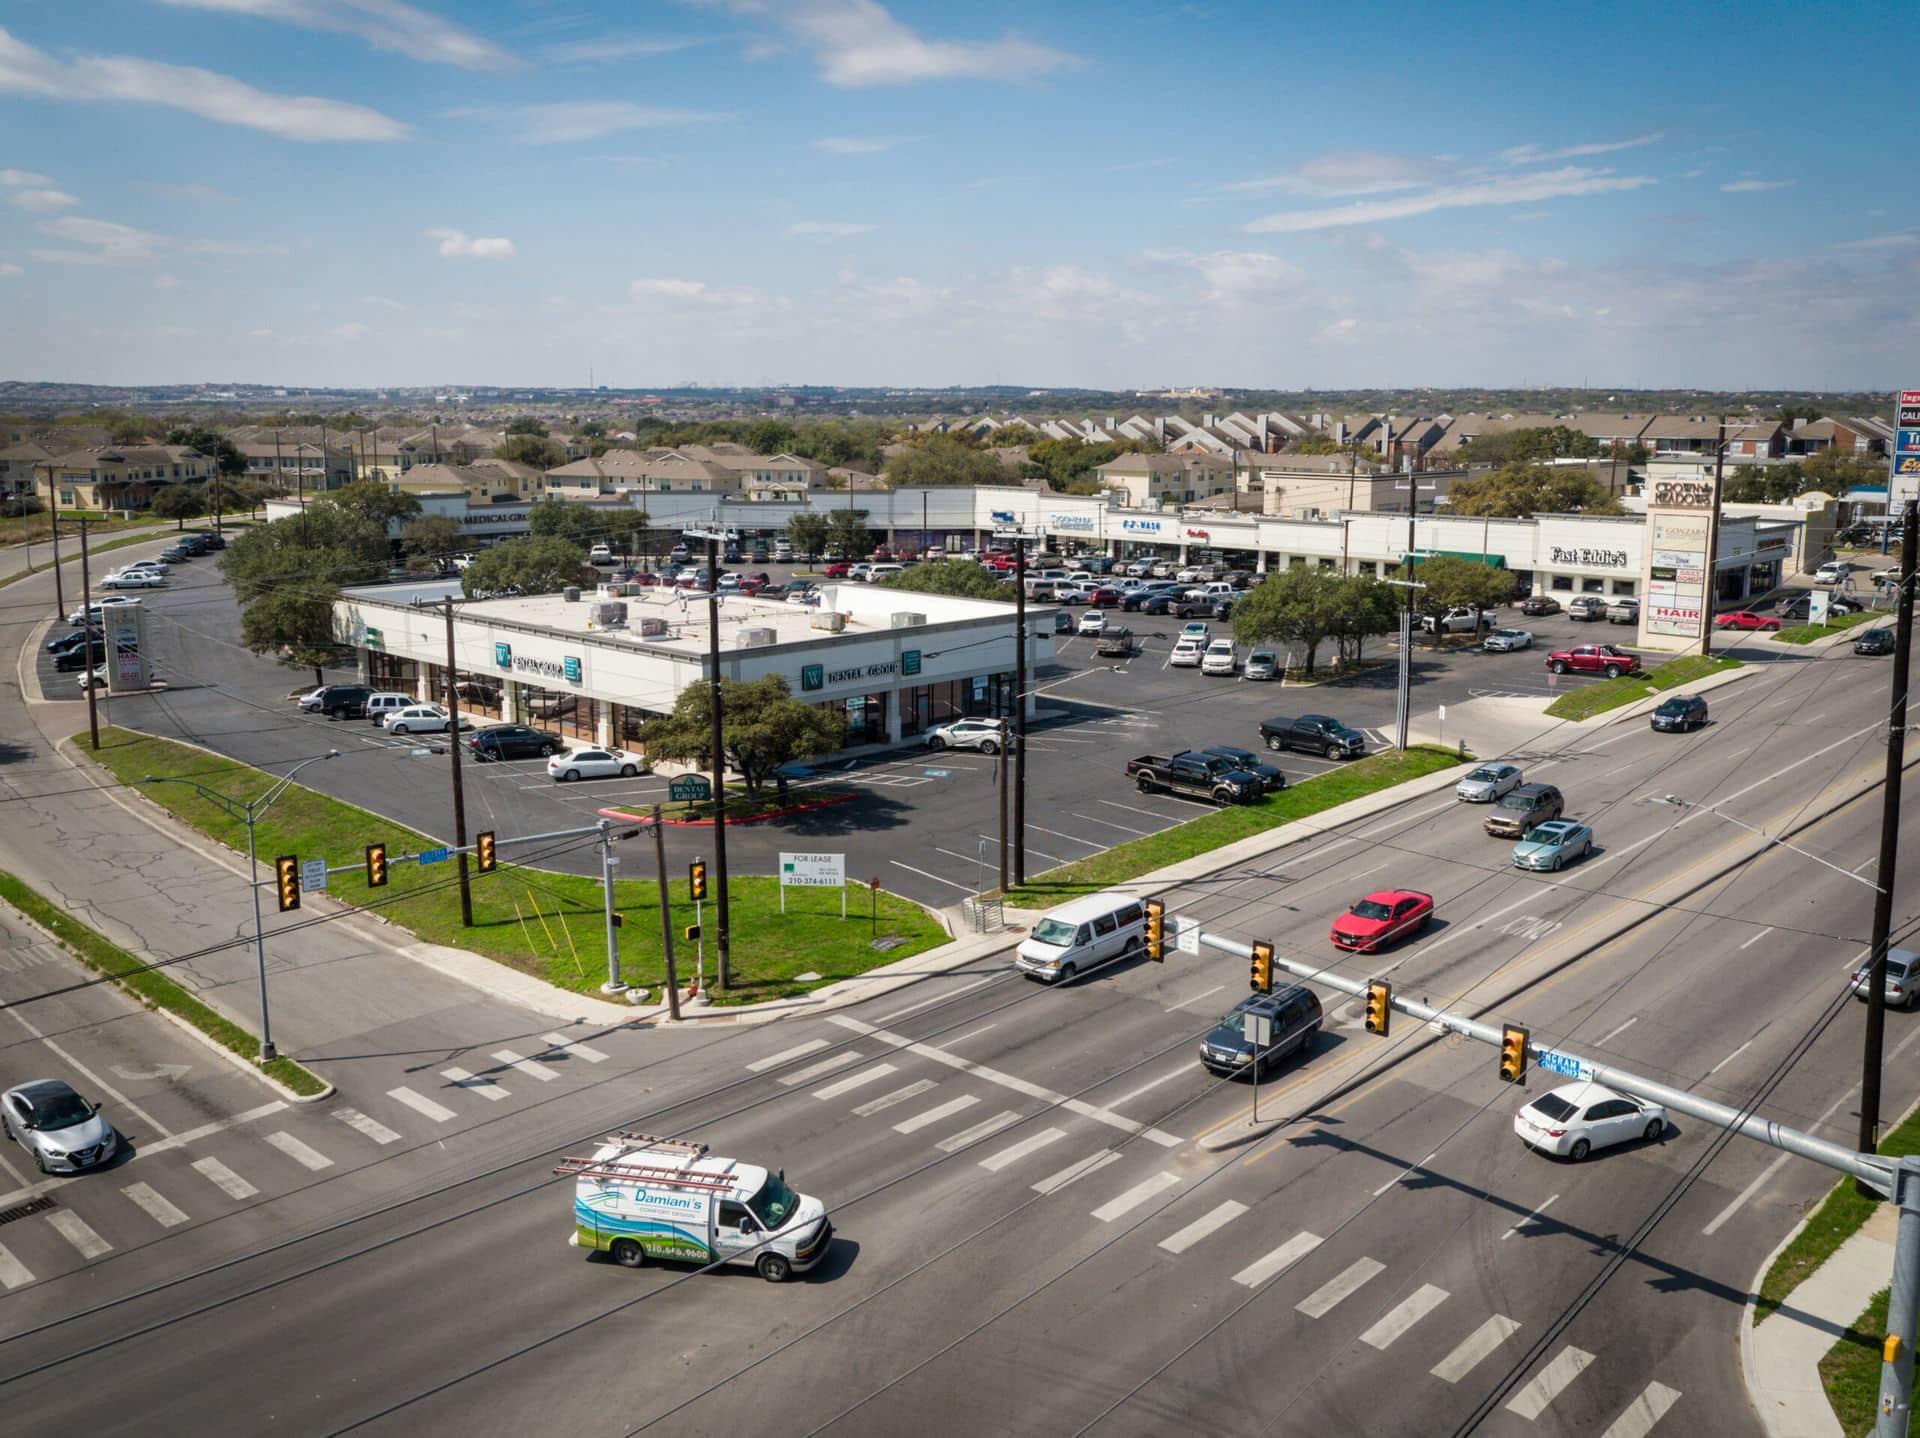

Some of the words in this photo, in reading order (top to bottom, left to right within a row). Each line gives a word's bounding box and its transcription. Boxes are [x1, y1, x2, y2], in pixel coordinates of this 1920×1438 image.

[1655, 482, 1703, 494] CROWN
[1655, 492, 1712, 505] MEADOWS
[464, 513, 508, 524] MEDICAL
[1550, 546, 1577, 563] Fast
[1580, 548, 1627, 567] Eddie's
[1656, 608, 1700, 619] HAIR
[808, 671, 819, 686] W
[829, 668, 864, 684] DENTAL
[868, 663, 898, 677] GROUP
[675, 792, 705, 800] GROUP
[793, 855, 809, 863] FOR
[811, 855, 832, 863] LEASE
[635, 1188, 703, 1210] Damiani's
